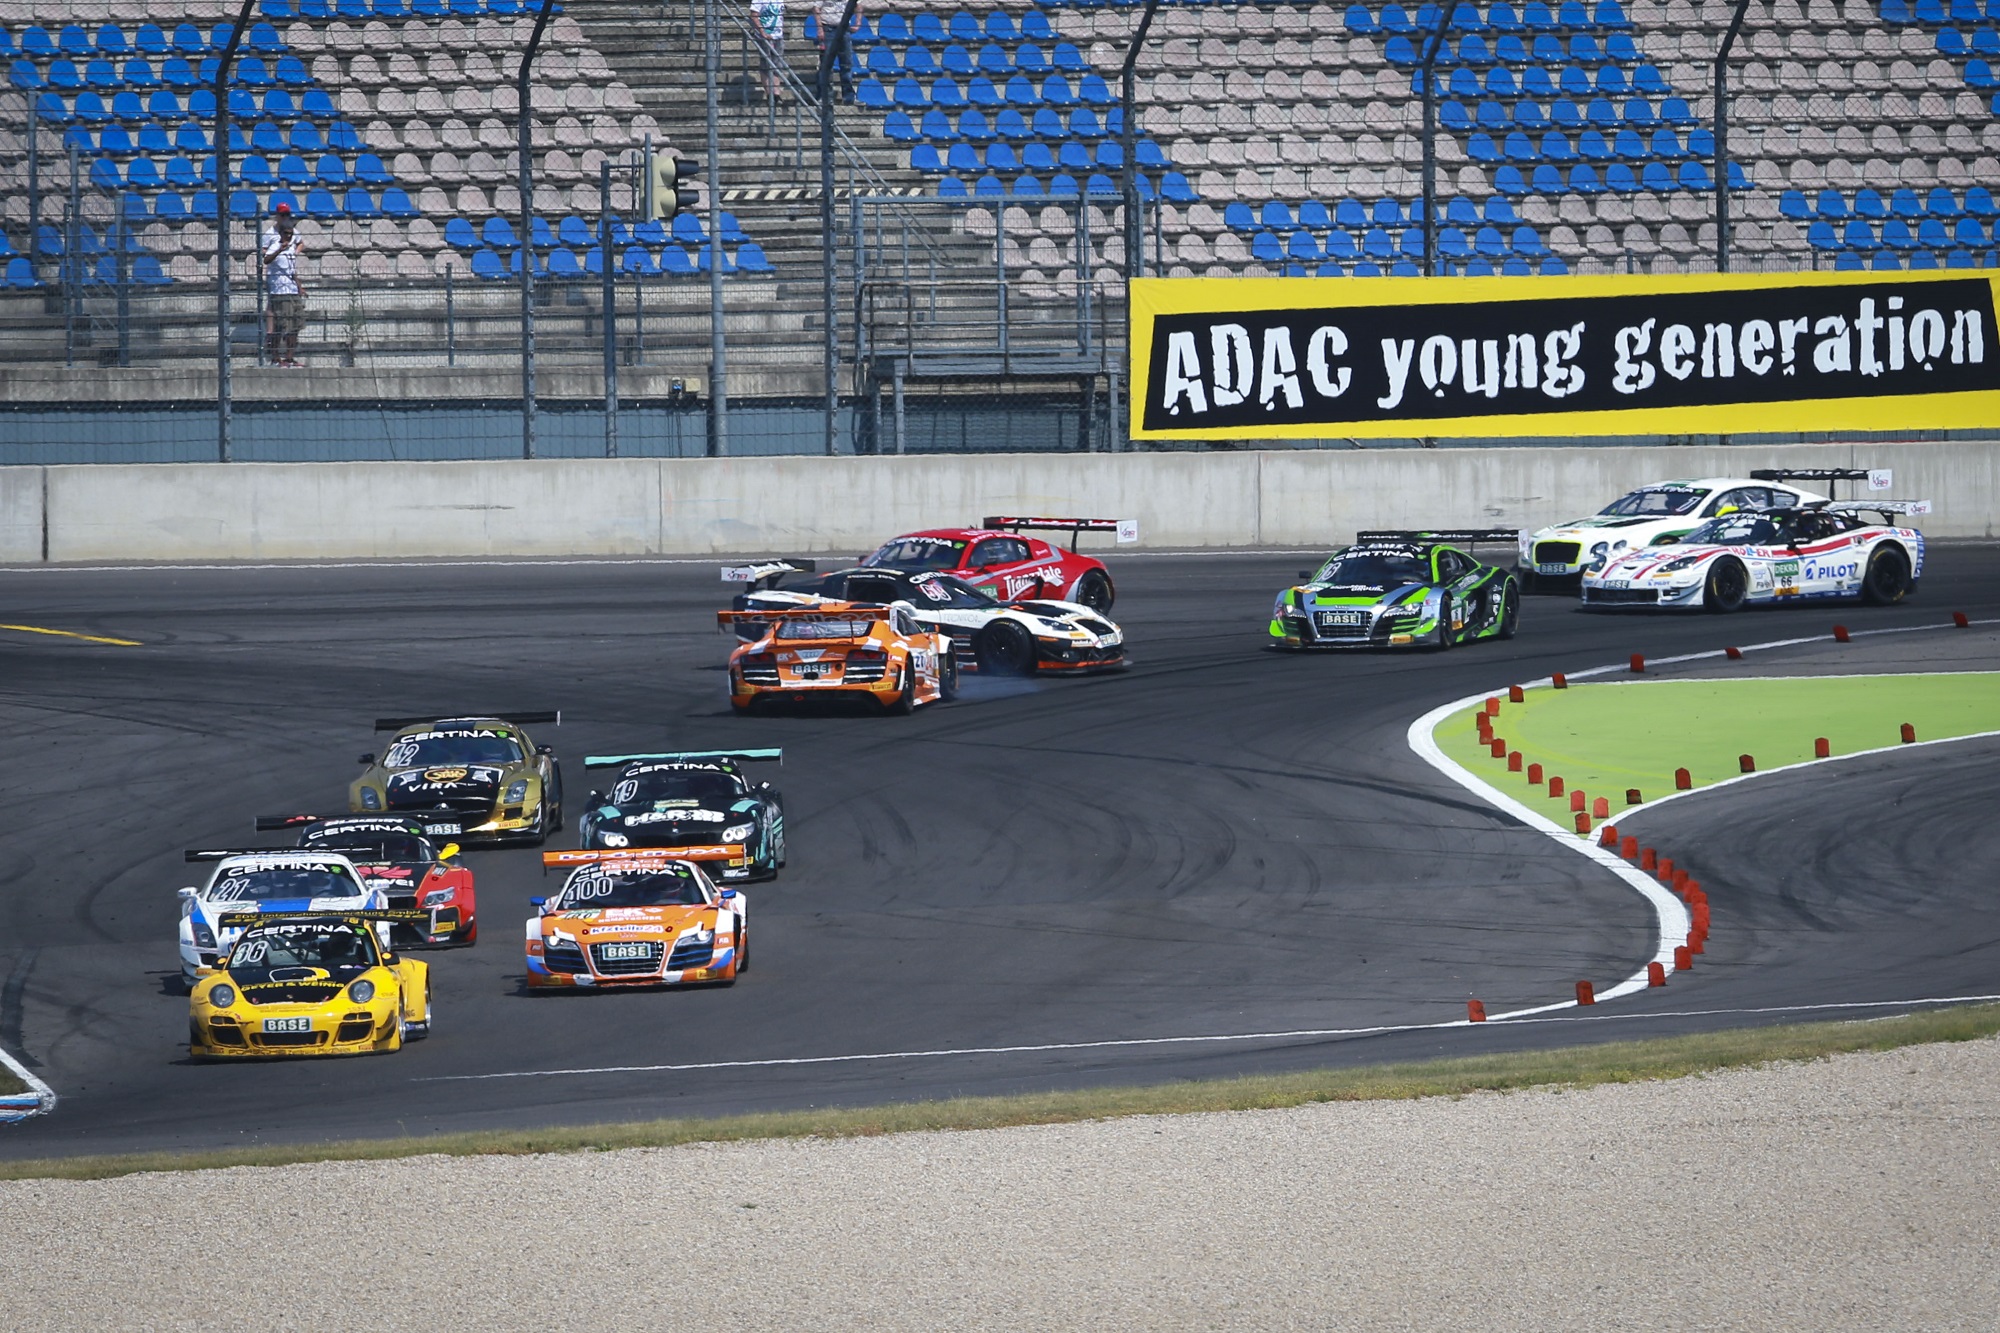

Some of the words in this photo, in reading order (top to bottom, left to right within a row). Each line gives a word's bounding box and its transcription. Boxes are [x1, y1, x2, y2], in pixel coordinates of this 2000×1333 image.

[1162, 326, 1352, 416] ADAC
[1377, 321, 1586, 410] young
[1612, 296, 1984, 394] generation
[1333, 550, 1415, 562] CERTINA
[1540, 564, 1565, 573] BASE
[1775, 561, 1799, 575] DEKRA
[1817, 564, 1857, 579] PILOT
[1604, 580, 1628, 589] BASE
[1780, 576, 1793, 588] 66
[1326, 614, 1357, 624] BASE
[794, 663, 827, 673] BASE
[401, 729, 497, 744] CERTINA
[625, 763, 721, 777] CERTINA
[613, 779, 639, 806] 19
[308, 823, 409, 841] CERTINA
[425, 823, 461, 835] BASE
[227, 863, 330, 878] CERTINA
[574, 868, 676, 883] CERTINA
[213, 878, 251, 901] 21
[570, 876, 614, 901] 100
[246, 924, 354, 939] CERTINA
[606, 946, 647, 958] BASE
[240, 982, 284, 992] GEYER
[267, 1019, 308, 1031] BASE
